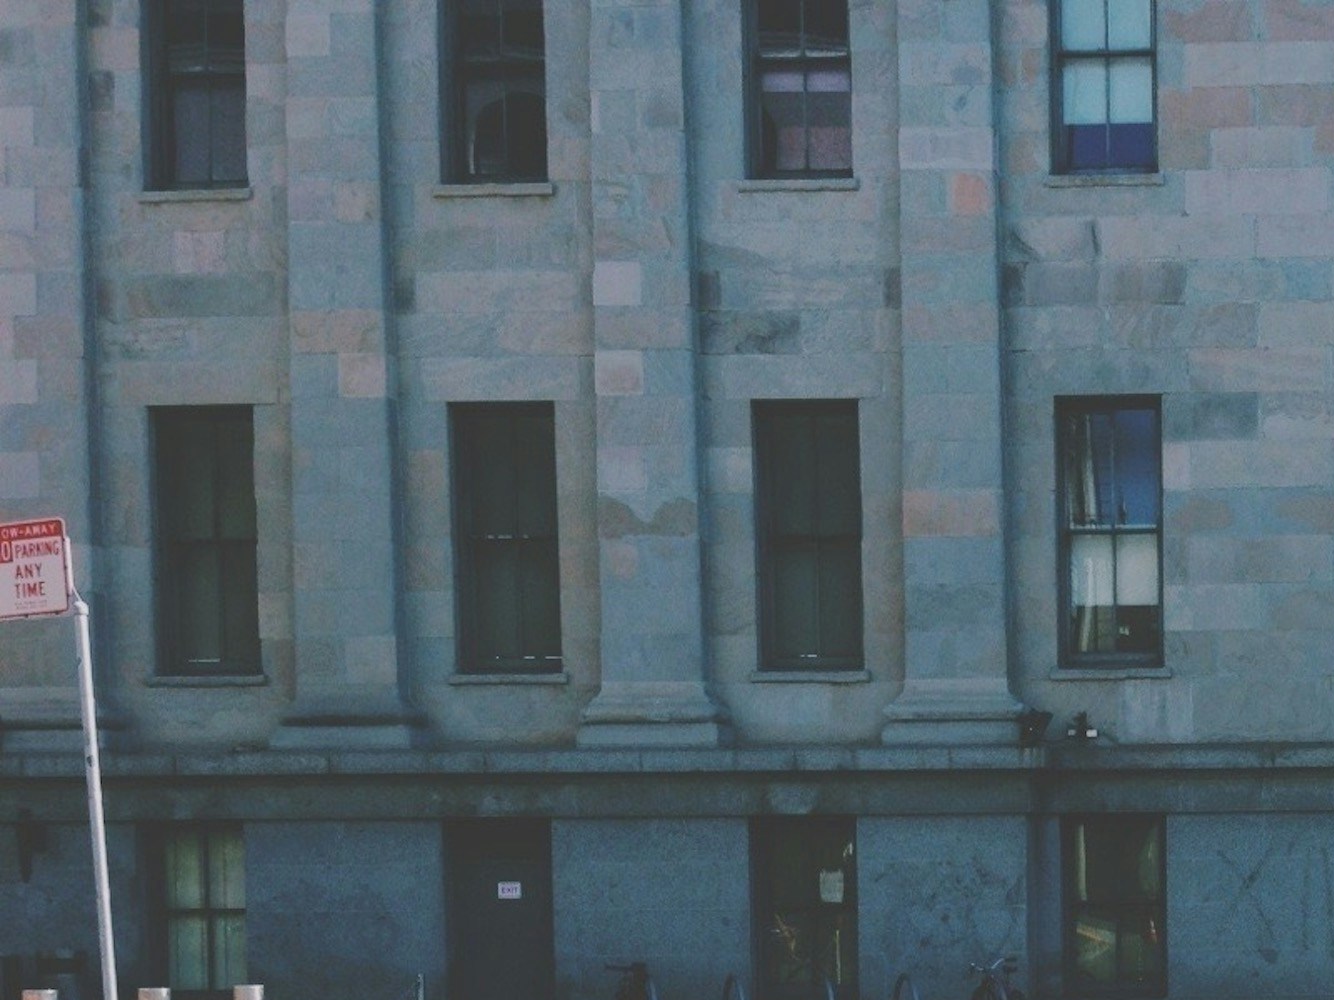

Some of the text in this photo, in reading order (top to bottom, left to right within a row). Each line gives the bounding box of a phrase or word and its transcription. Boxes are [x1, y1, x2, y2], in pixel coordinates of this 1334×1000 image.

[0, 523, 56, 539] OW-AWAY
[14, 541, 60, 559] PARKING
[15, 563, 42, 579] ANY
[15, 581, 46, 599] TIME
[501, 886, 519, 895] EXIT
